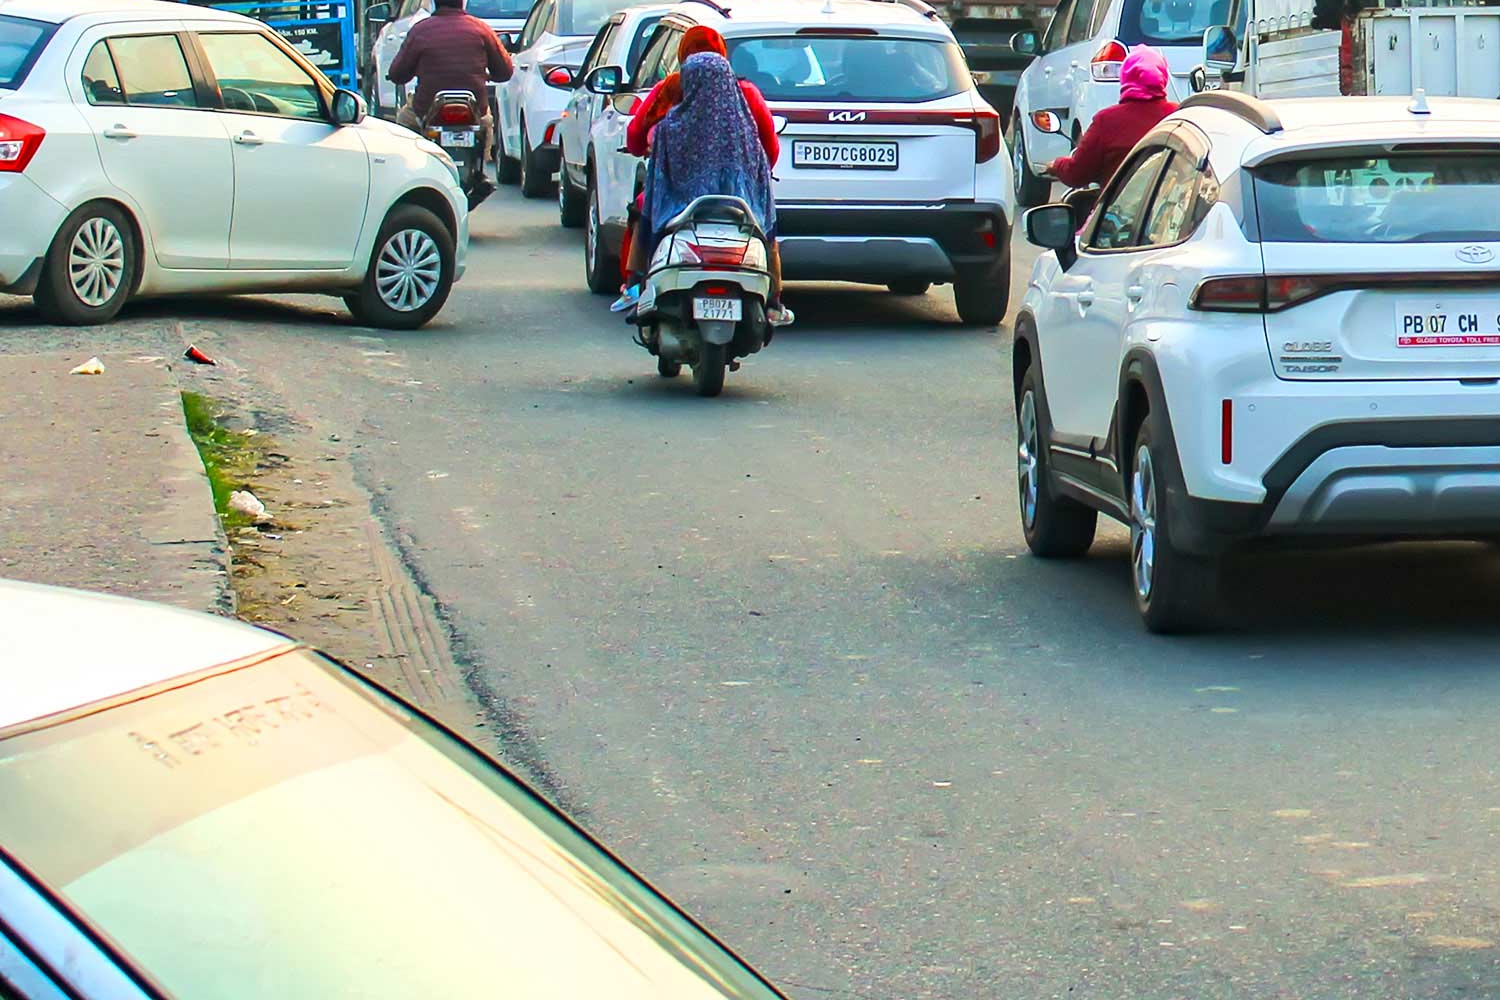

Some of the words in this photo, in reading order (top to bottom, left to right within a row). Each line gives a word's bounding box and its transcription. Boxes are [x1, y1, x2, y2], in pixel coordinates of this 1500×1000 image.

[828, 111, 866, 122] KIA
[804, 146, 895, 162] PB07CG8029
[1403, 315, 1424, 334] PB
[1429, 315, 1447, 333] 07
[1458, 314, 1478, 333] CH
